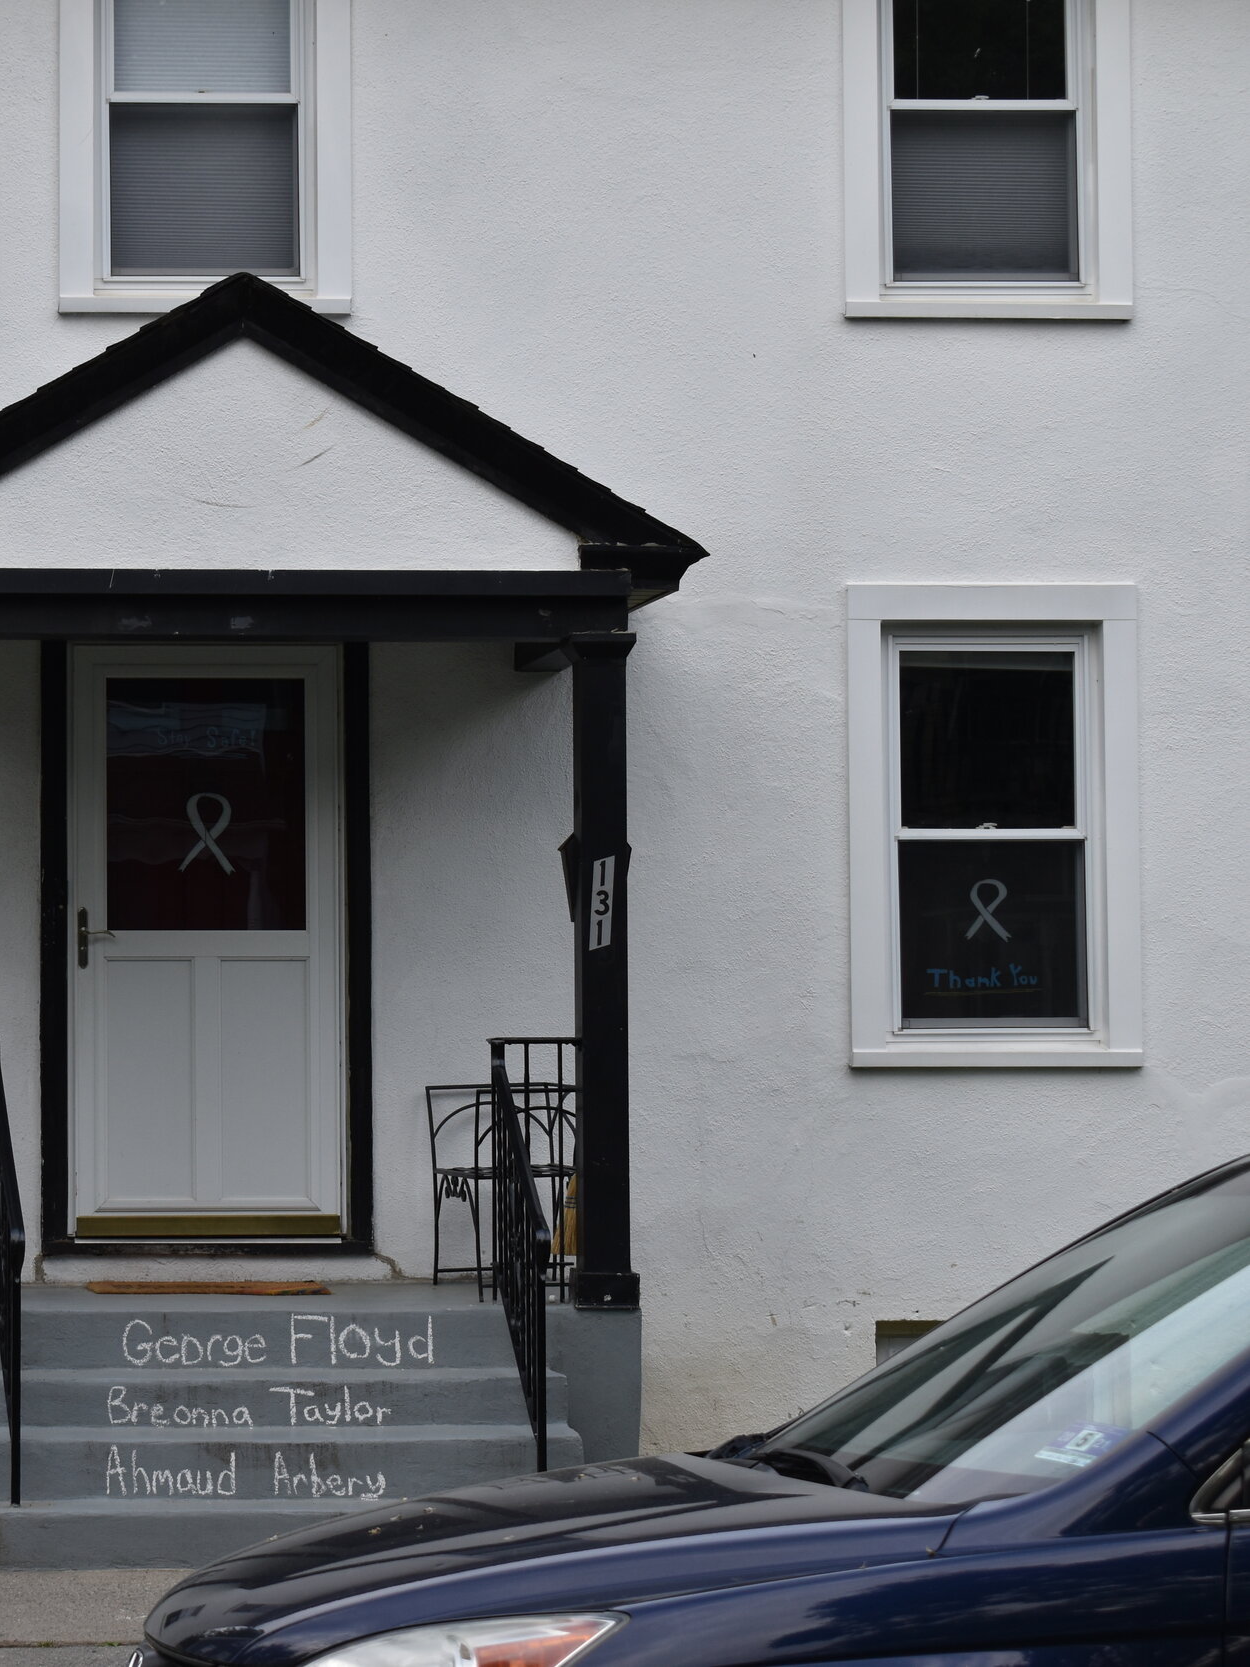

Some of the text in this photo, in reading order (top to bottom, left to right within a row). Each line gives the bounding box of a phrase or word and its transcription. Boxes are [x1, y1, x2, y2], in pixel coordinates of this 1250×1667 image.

[594, 860, 610, 946] 131
[925, 962, 1038, 989] Thank You
[121, 1313, 436, 1367] George Floyd
[106, 1385, 392, 1430] Breonna Taylor
[105, 1444, 387, 1501] Ahmaud Arbery
